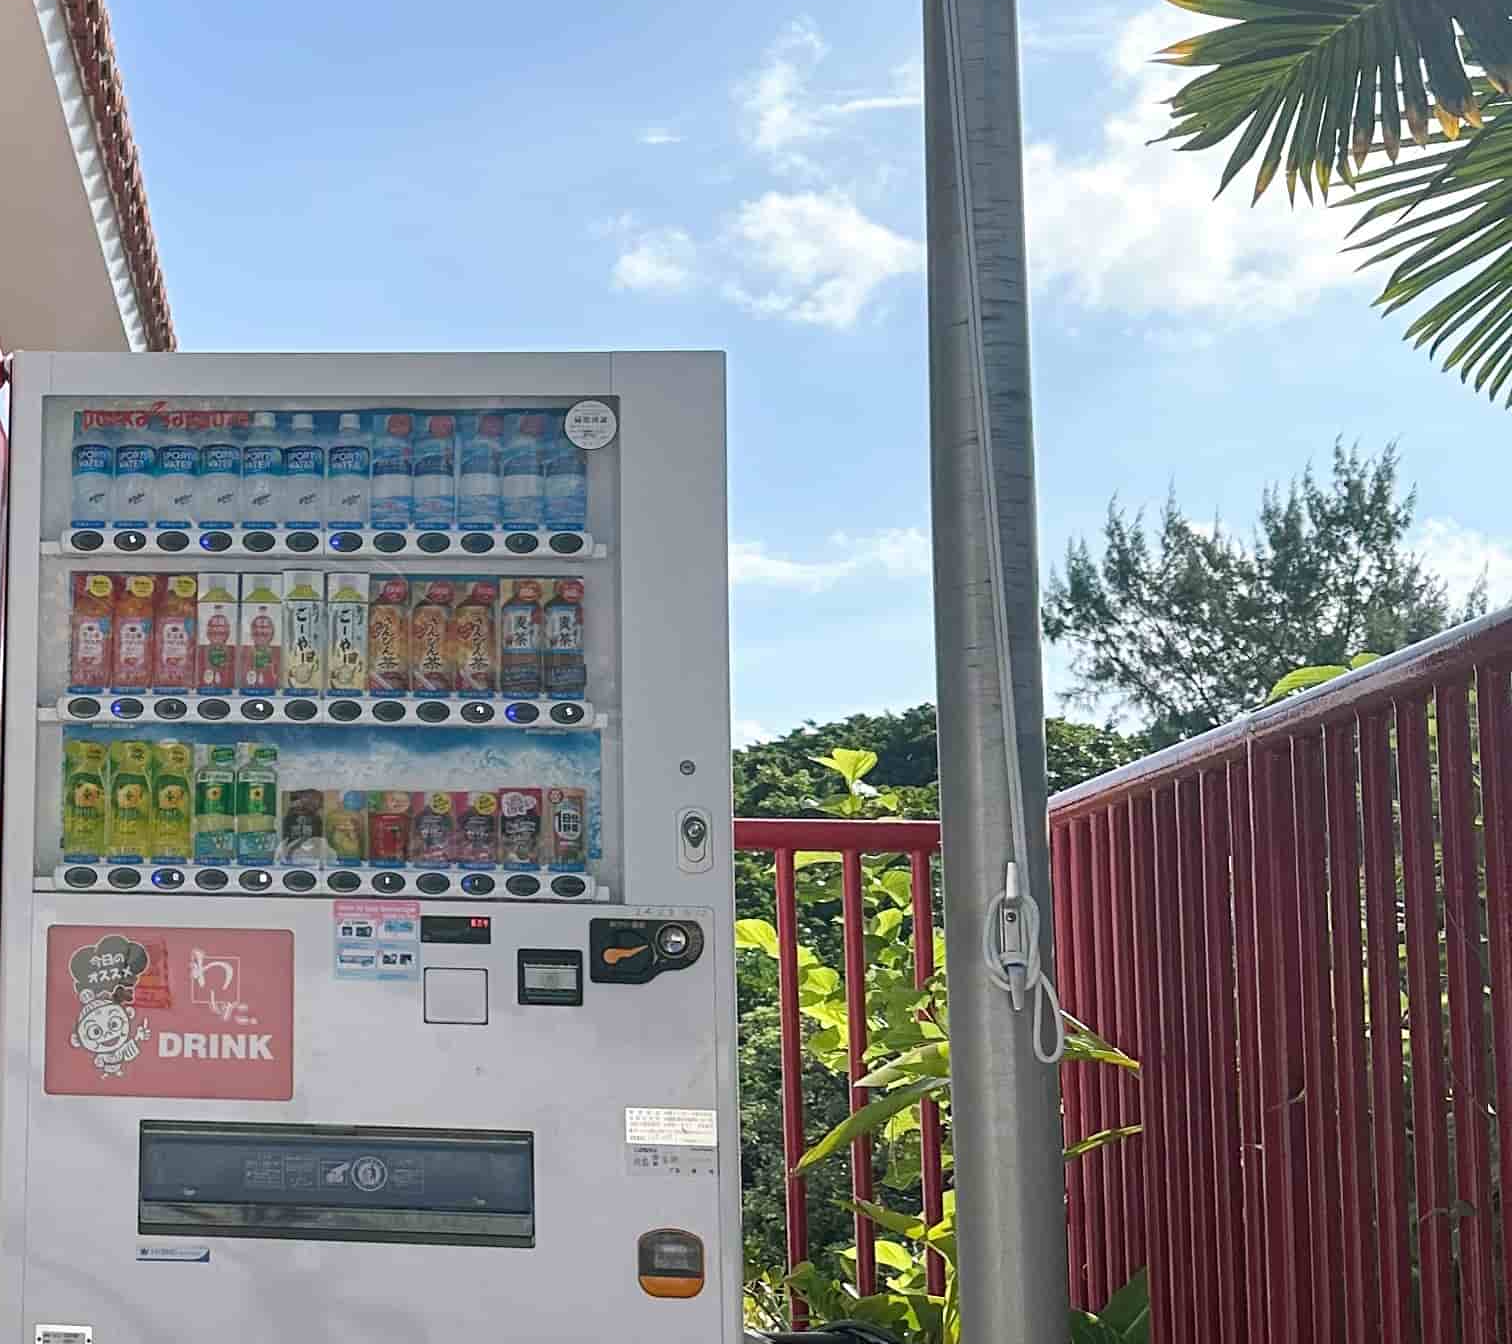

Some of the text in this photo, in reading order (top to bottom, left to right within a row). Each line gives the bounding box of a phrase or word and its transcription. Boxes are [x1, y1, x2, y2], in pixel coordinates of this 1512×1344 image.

[89, 952, 126, 968] 今日の
[88, 965, 133, 985] オススメ
[158, 1032, 275, 1061] DRINK
